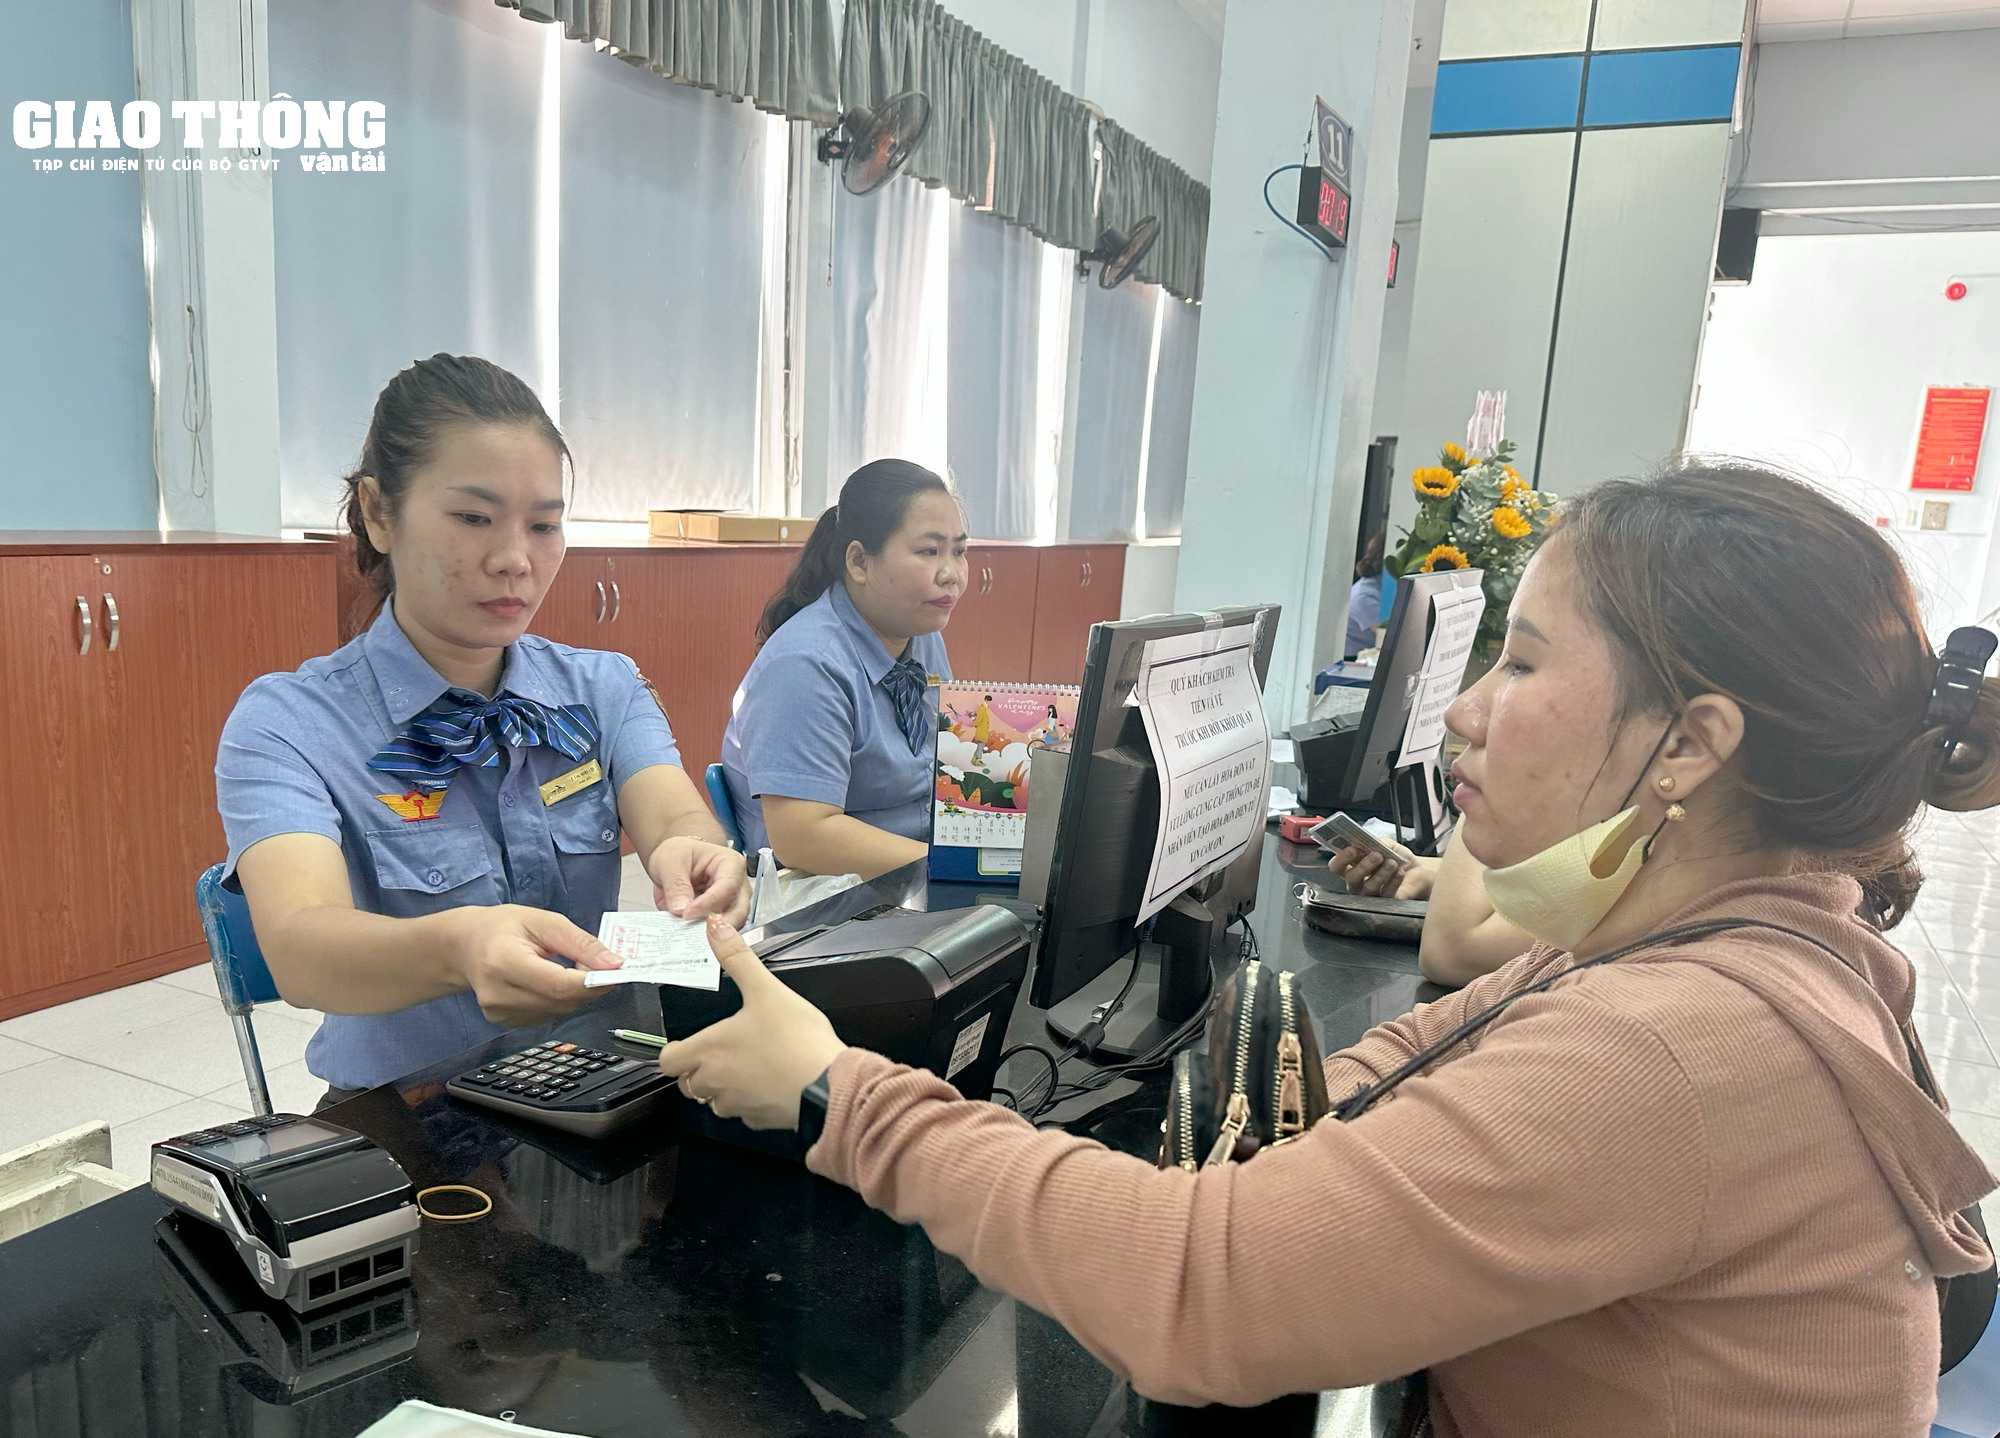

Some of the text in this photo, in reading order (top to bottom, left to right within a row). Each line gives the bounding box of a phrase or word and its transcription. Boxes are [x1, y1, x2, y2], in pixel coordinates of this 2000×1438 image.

[1327, 123, 1345, 172] 11
[1170, 672, 1187, 695] QUÝ
[1187, 669, 1212, 689] KHÁCH
[1196, 725, 1212, 741] KHI
